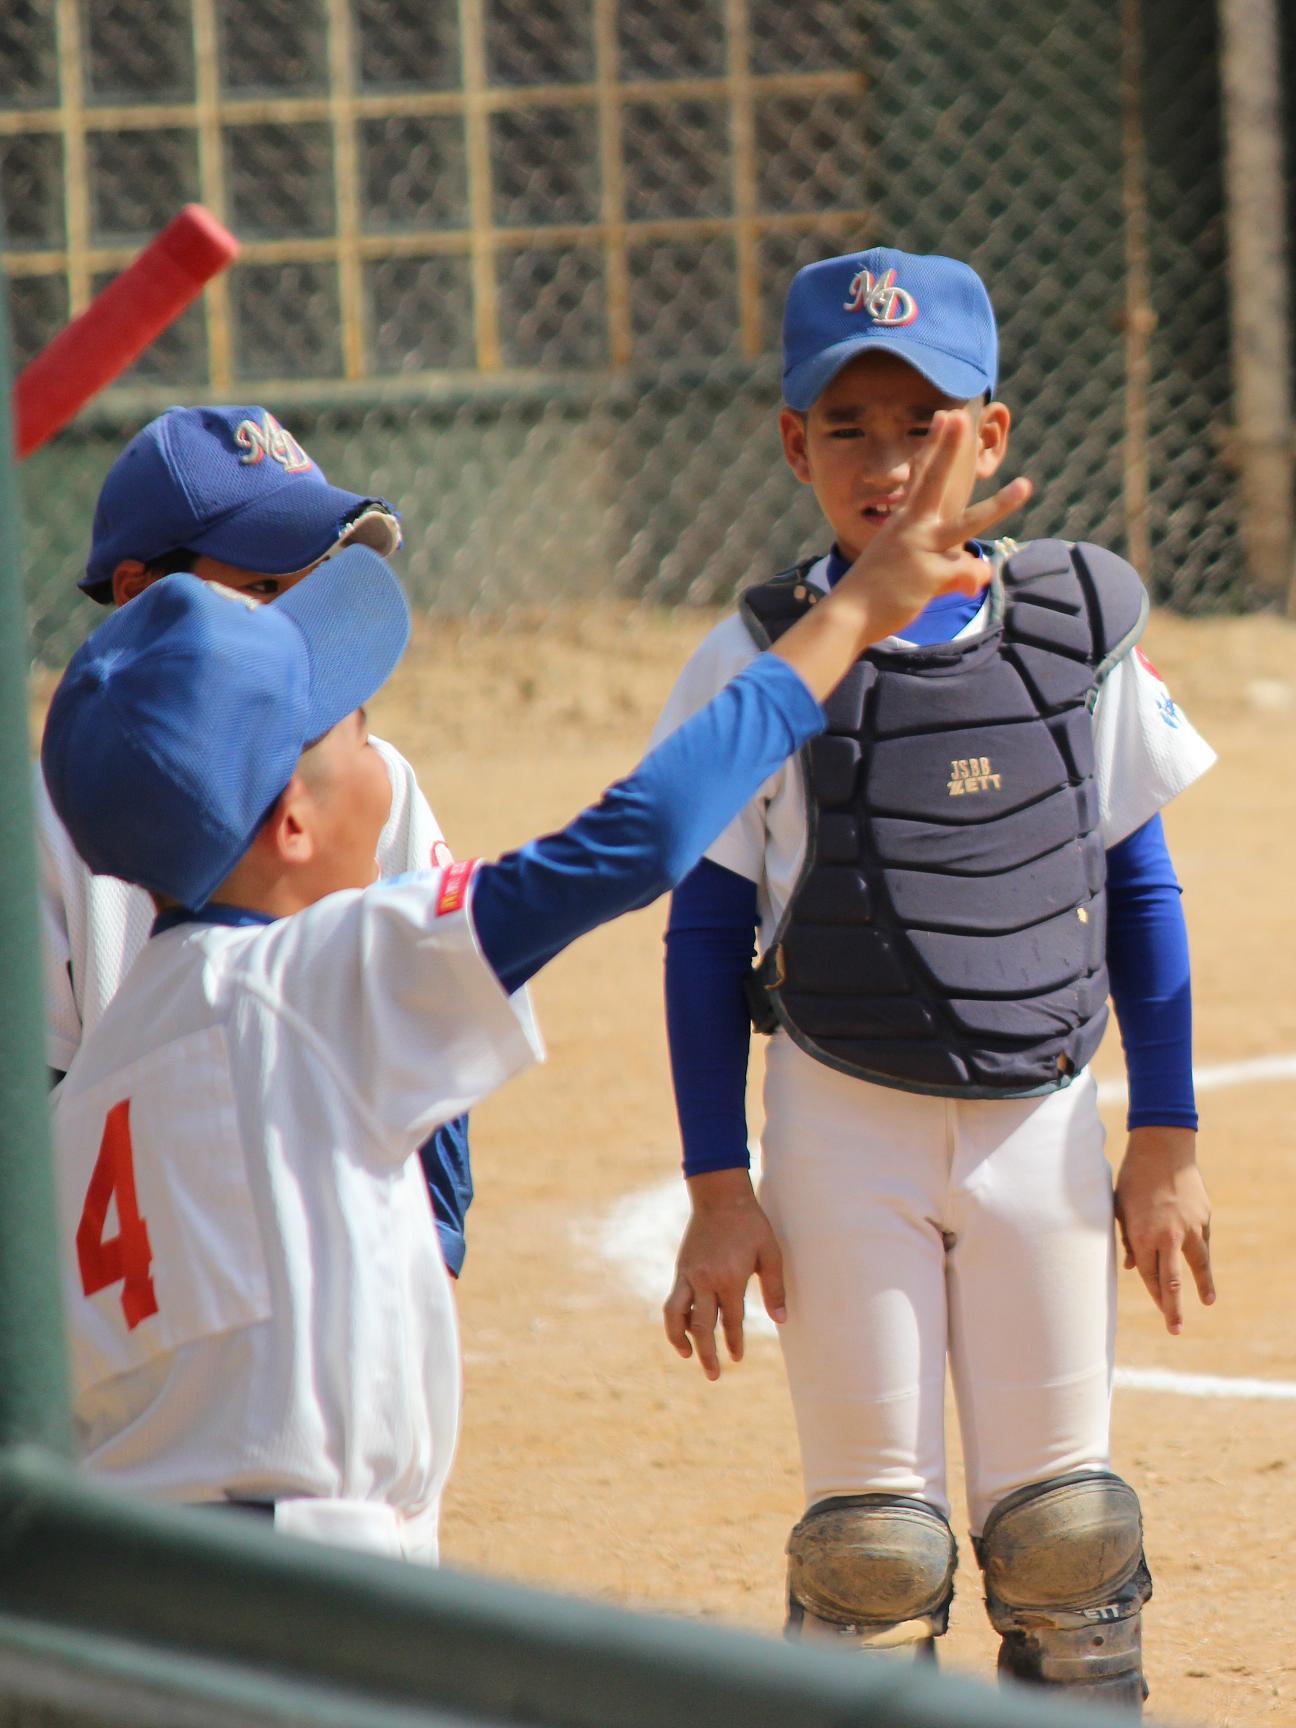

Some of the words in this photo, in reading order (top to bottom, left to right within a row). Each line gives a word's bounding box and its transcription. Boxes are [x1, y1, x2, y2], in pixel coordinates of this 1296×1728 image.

[843, 267, 919, 328] MD
[234, 412, 313, 474] MD
[946, 773, 1001, 797] ZETT
[76, 1096, 159, 1332] 4
